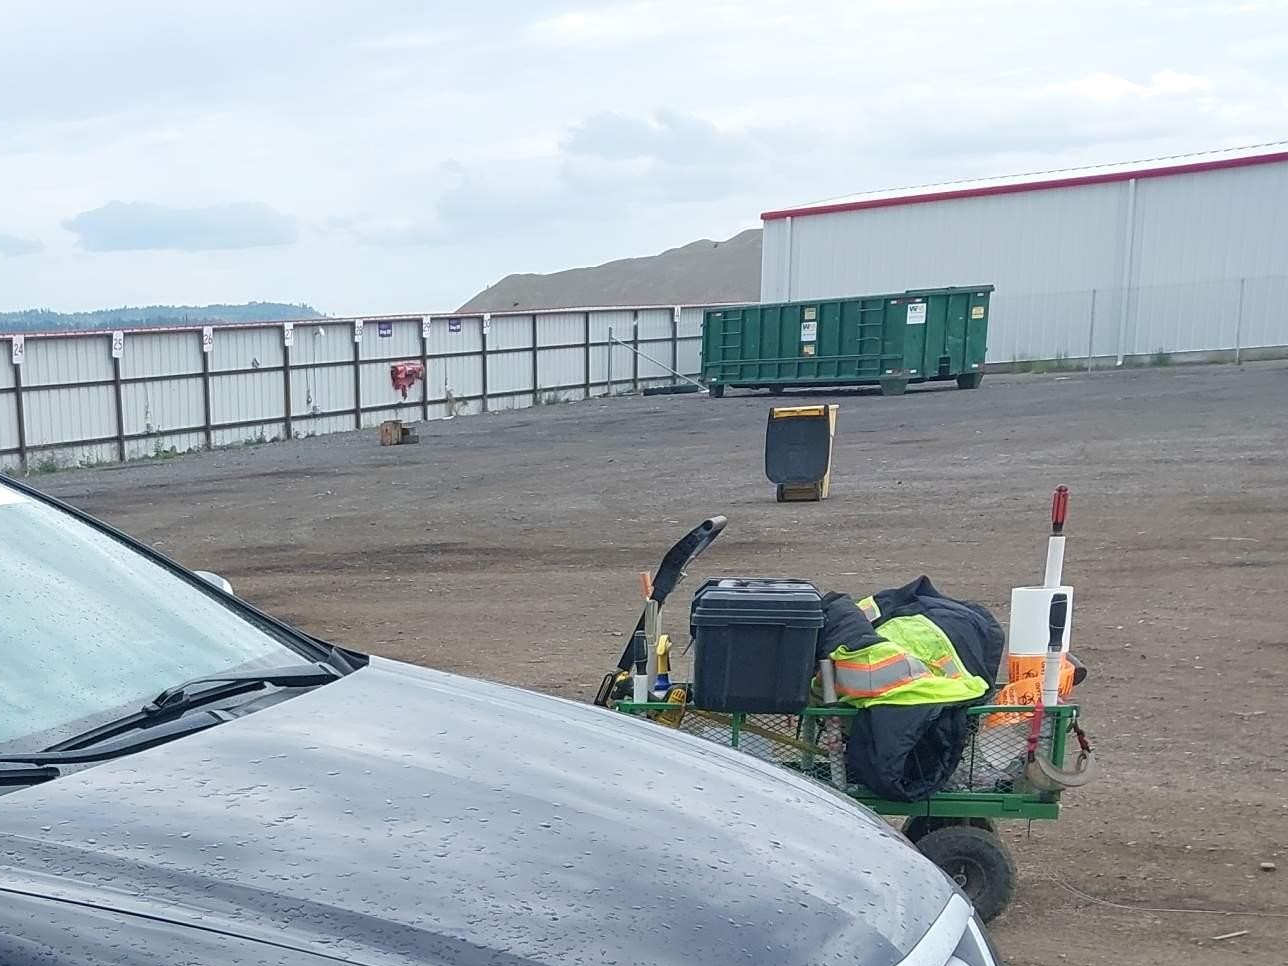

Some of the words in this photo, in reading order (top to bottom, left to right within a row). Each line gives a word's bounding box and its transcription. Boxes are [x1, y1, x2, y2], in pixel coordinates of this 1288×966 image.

[203, 334, 213, 345] 26
[284, 328, 294, 340] 27
[14, 343, 24, 356] 24
[113, 338, 123, 351] 25
